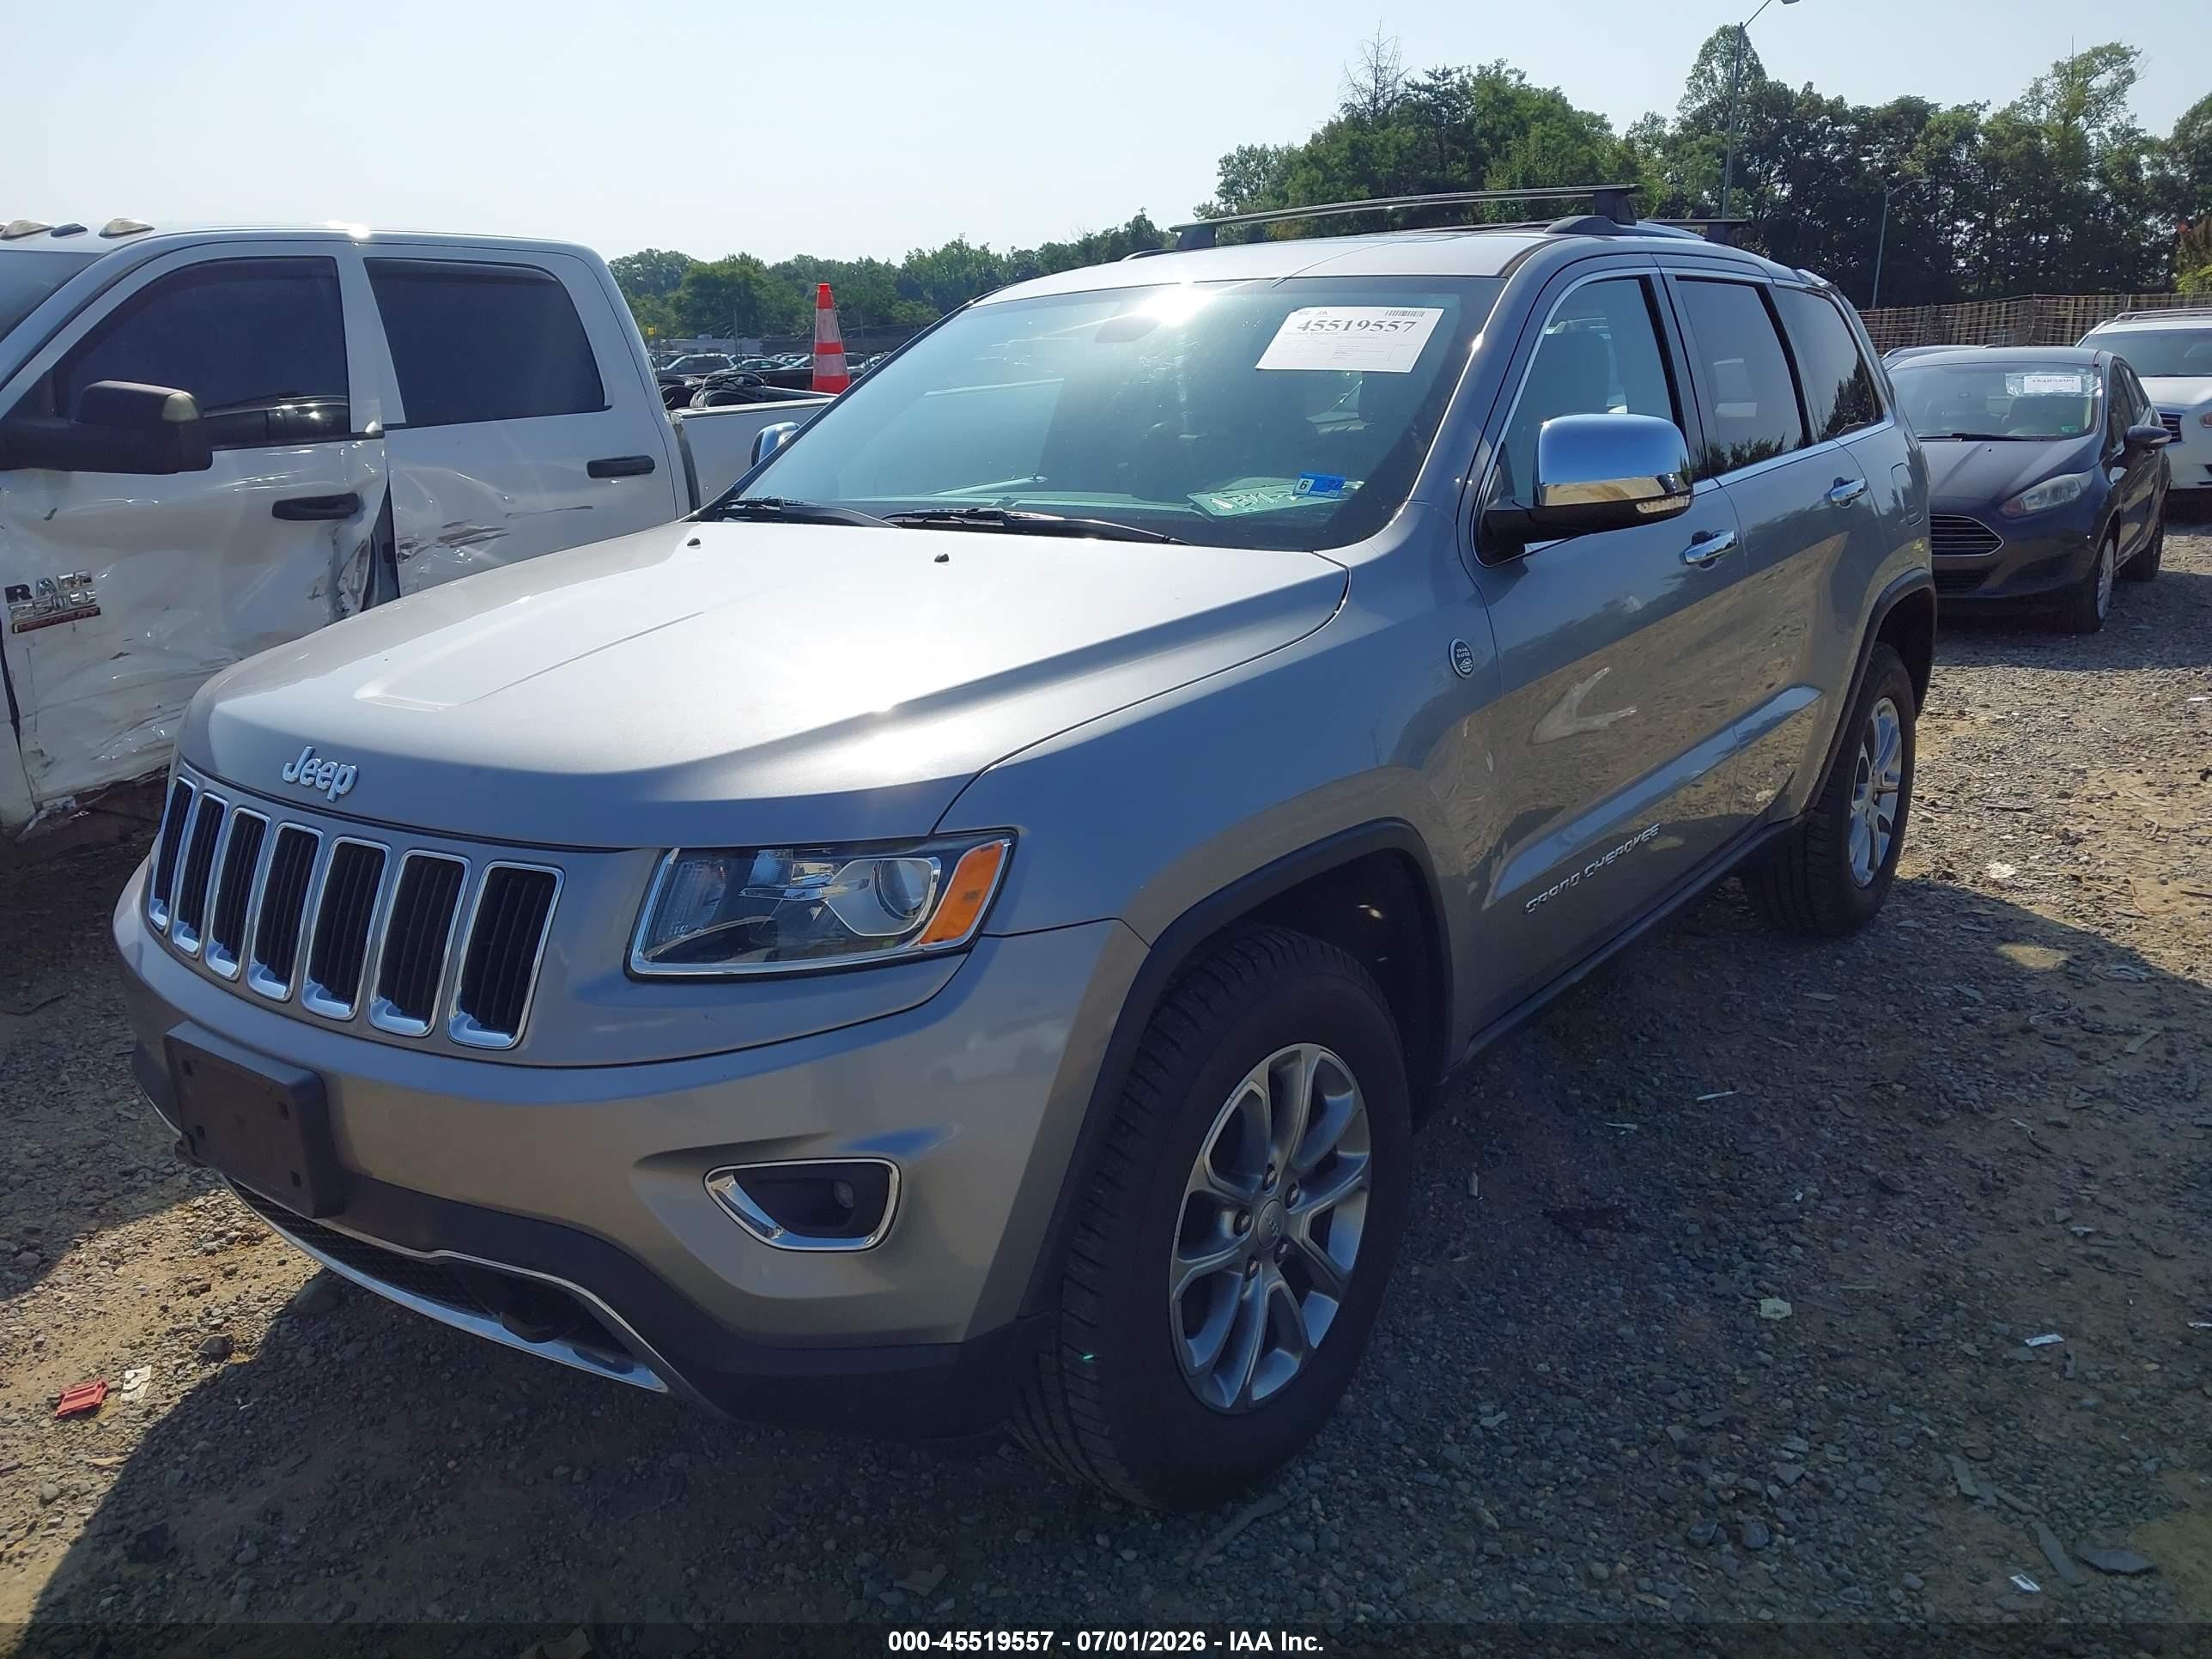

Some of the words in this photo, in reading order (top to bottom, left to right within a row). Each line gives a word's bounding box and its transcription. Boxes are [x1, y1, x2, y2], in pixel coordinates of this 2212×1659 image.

[1296, 319, 1418, 333] 45519557
[1299, 480, 1310, 490] 6
[4, 570, 94, 604] RAM
[9, 590, 97, 622] 2500
[282, 745, 359, 803] Jeep
[1525, 872, 1581, 914] GRAND
[1584, 823, 1660, 878] CHEROKEE
